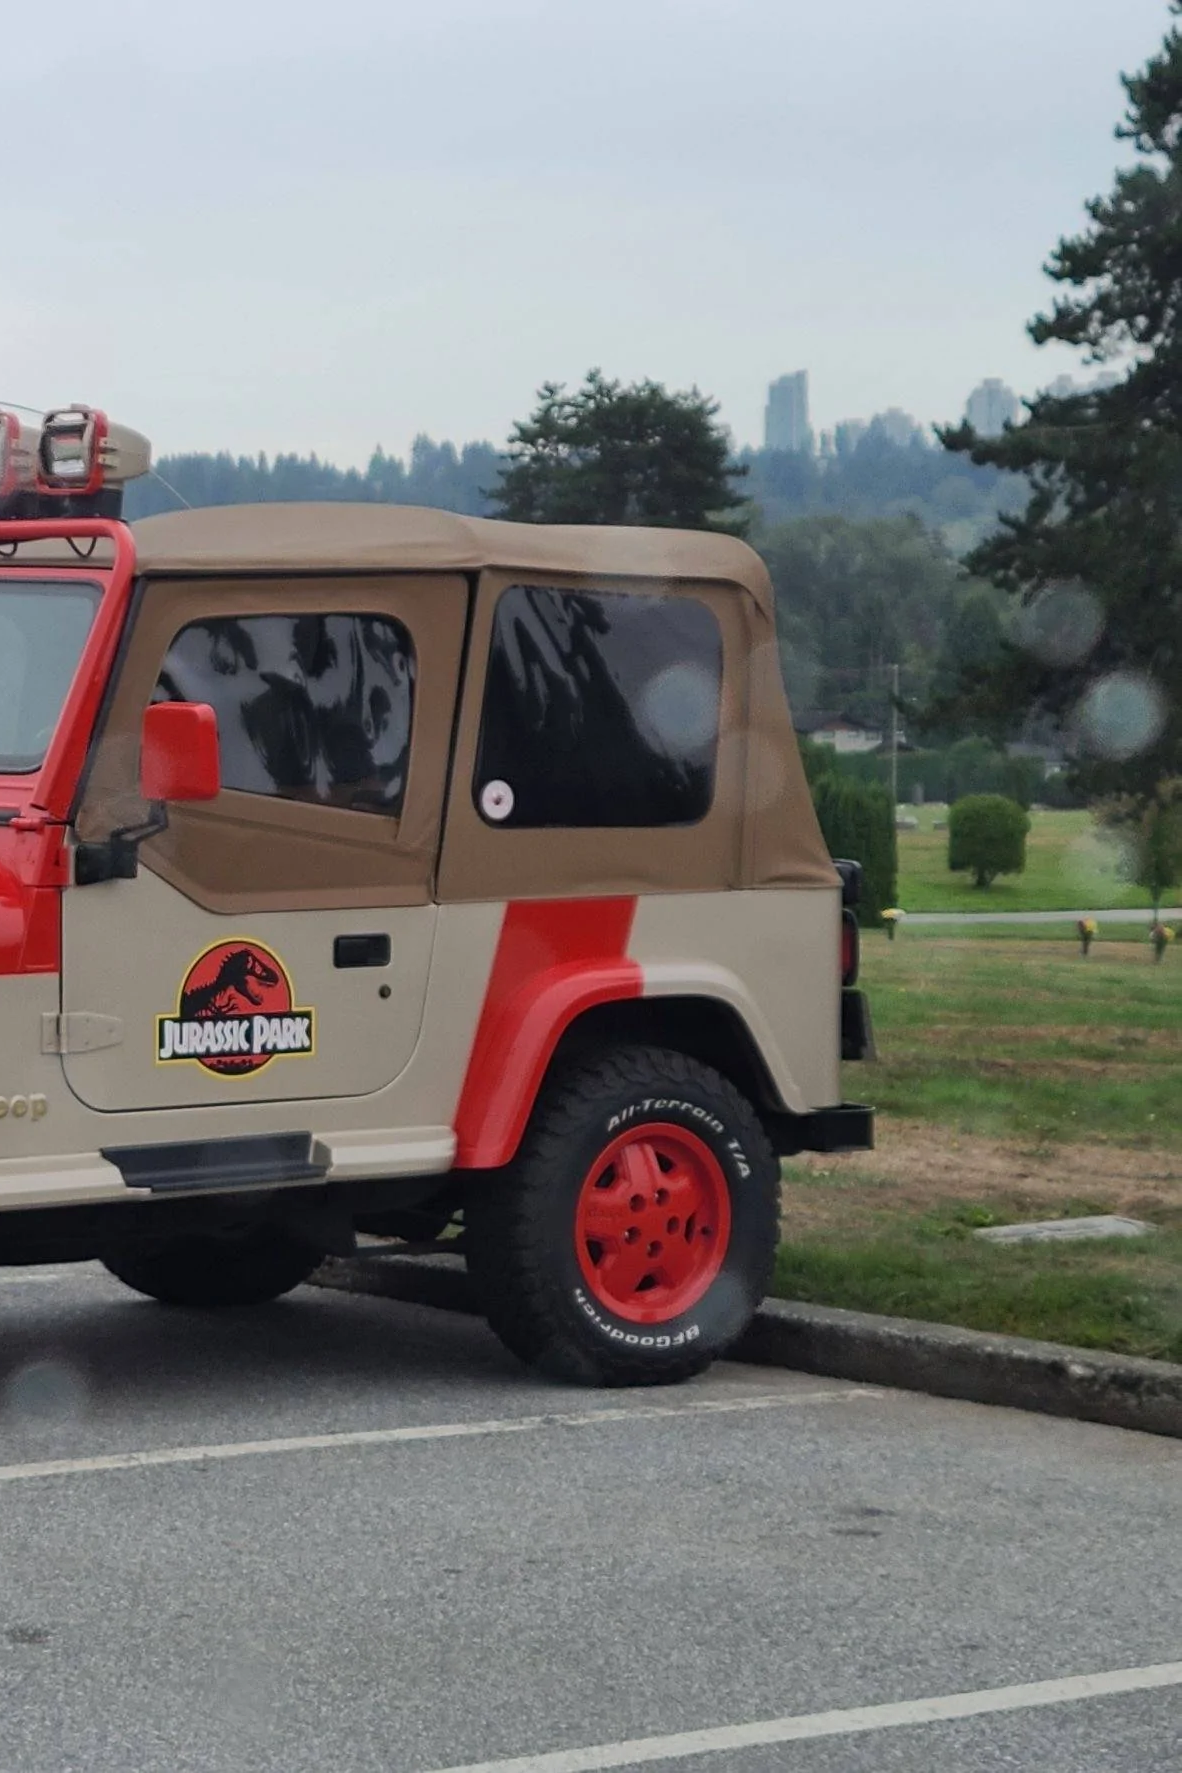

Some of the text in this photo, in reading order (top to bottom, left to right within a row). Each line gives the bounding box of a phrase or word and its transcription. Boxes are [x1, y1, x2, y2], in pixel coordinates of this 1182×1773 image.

[160, 1015, 310, 1058] JURASSIC PARK
[607, 1098, 751, 1178] All-Terrain T/A
[575, 1288, 700, 1347] BFGoodrich
